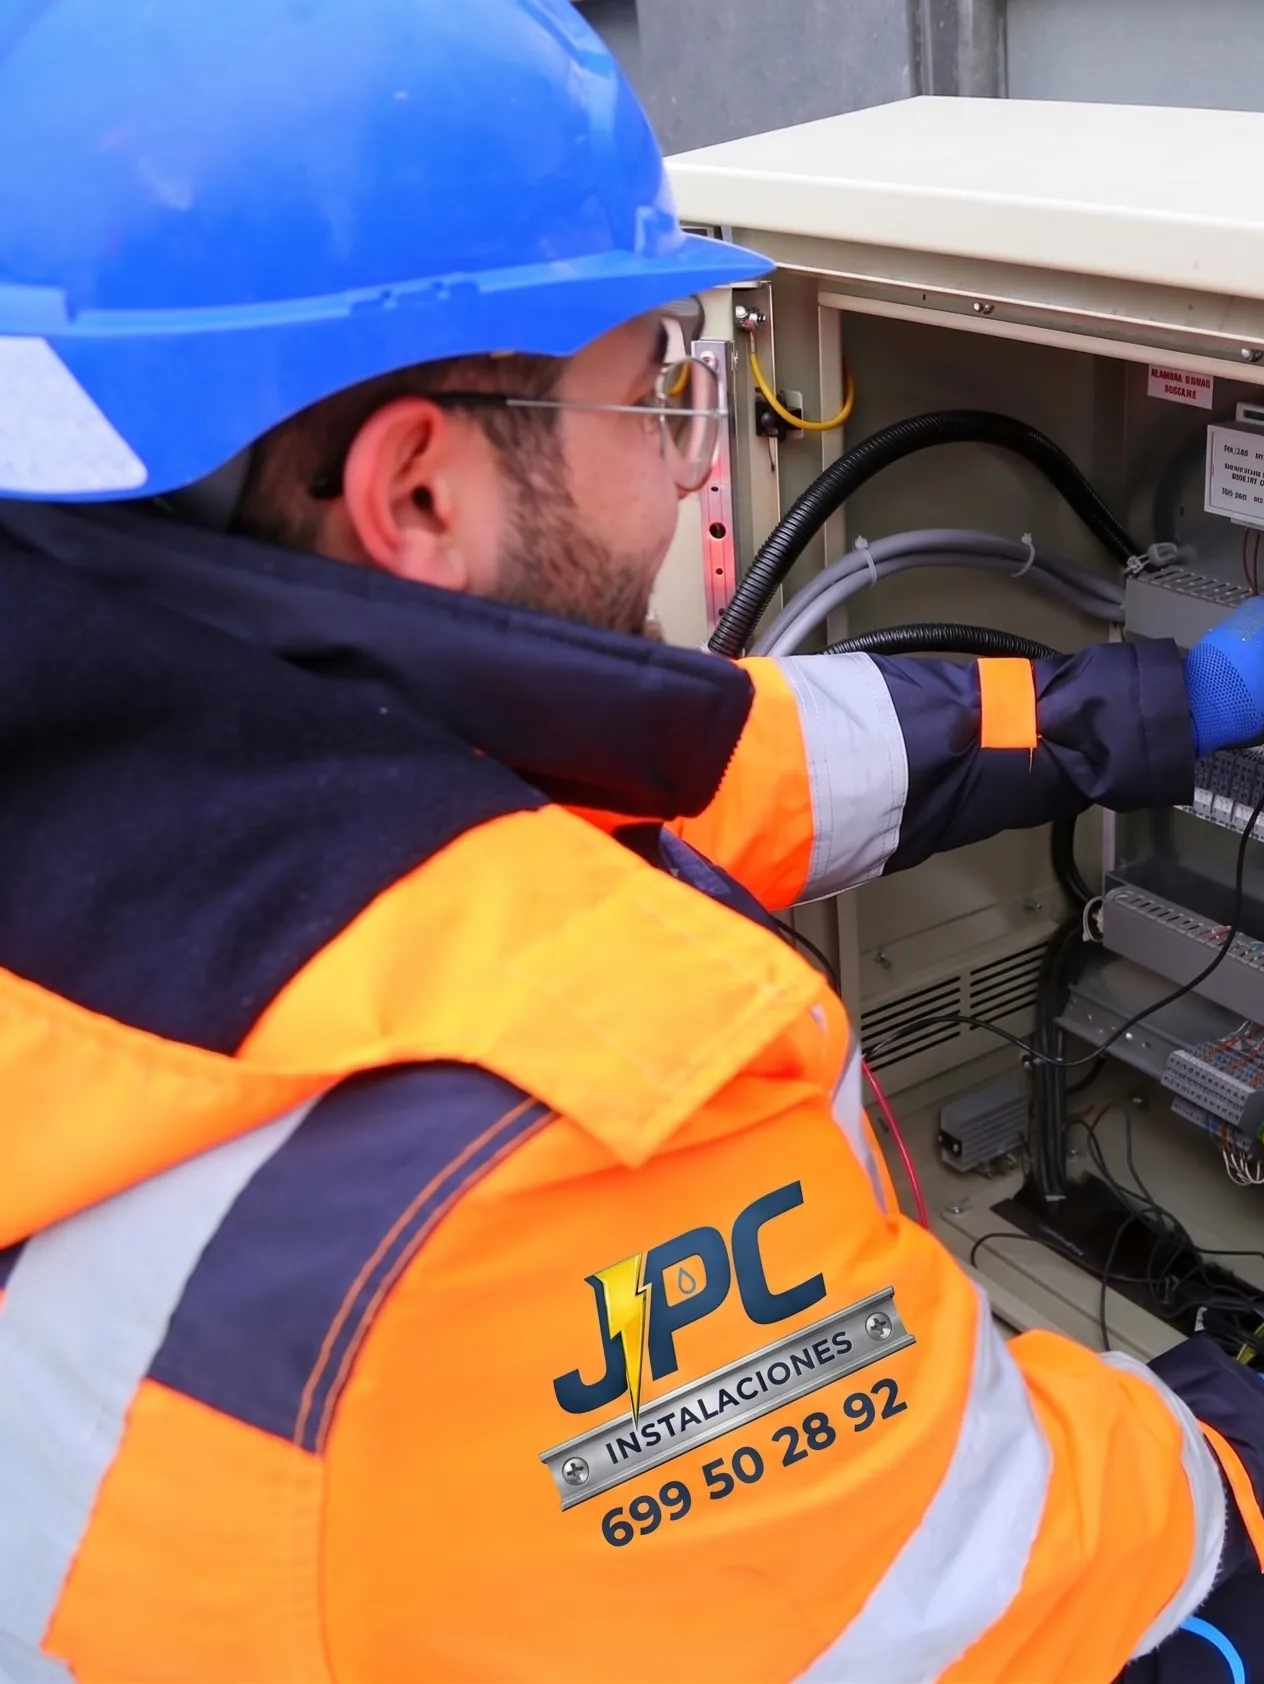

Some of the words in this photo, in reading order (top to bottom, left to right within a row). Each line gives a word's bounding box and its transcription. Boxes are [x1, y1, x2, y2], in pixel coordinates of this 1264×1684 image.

[553, 1180, 827, 1414] JPC
[601, 1480, 692, 1547] 699
[702, 1446, 764, 1501] 50
[772, 1412, 837, 1467] 28
[843, 1378, 908, 1432] 92
[605, 1331, 853, 1464] INSTALACIONES
